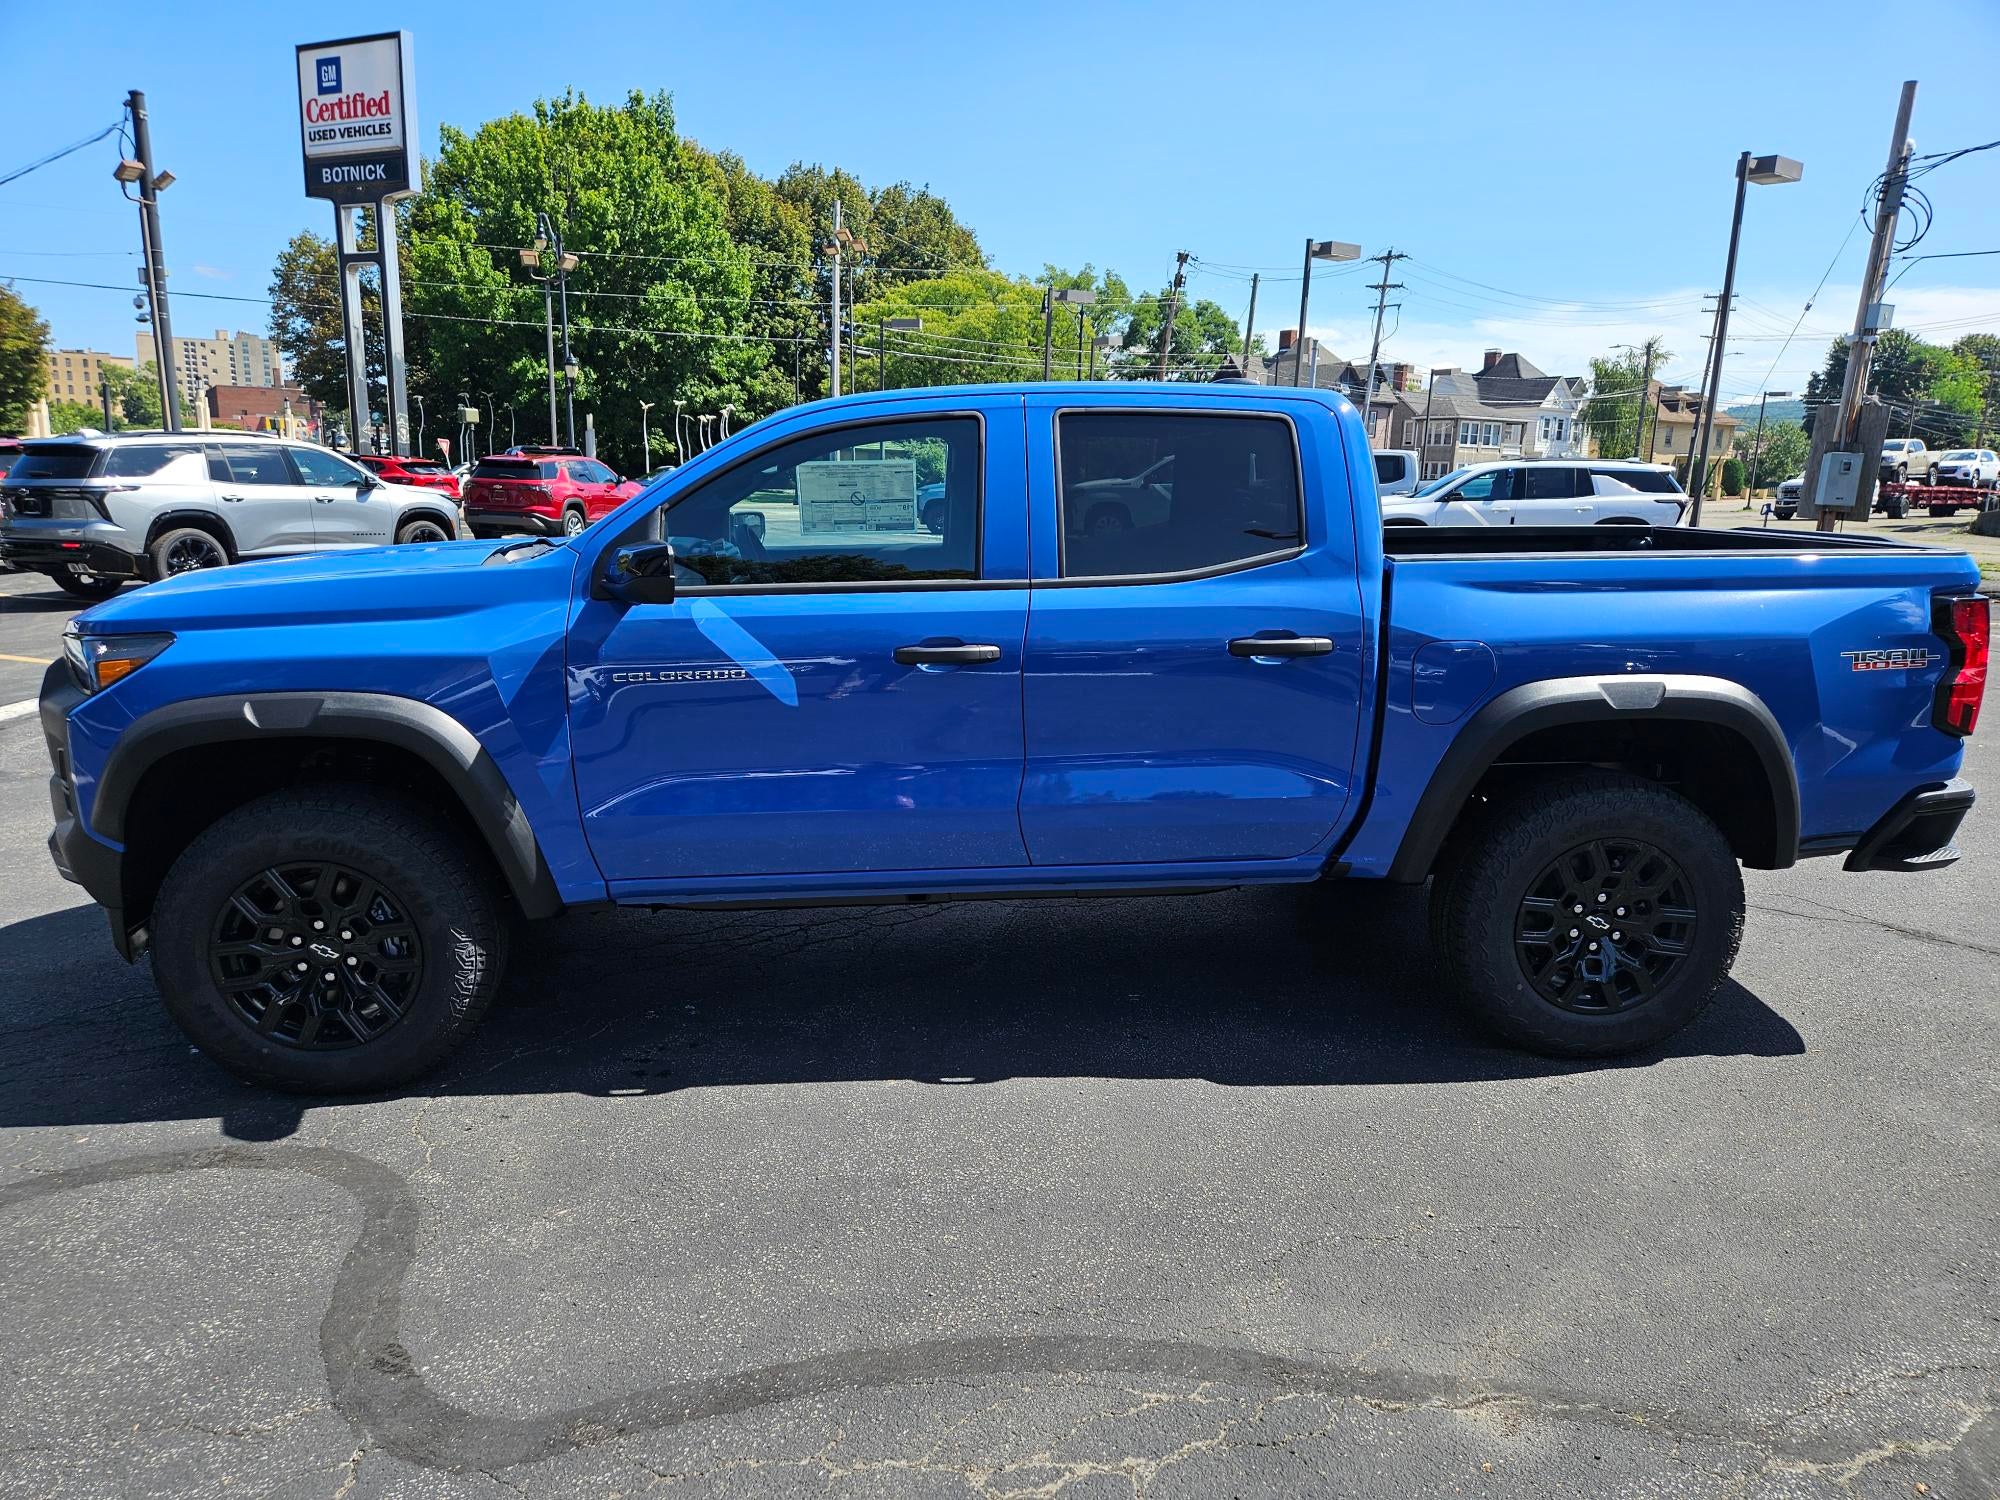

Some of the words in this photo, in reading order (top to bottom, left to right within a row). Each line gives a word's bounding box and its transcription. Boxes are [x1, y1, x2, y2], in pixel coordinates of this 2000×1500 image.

[321, 65, 337, 81] GM
[306, 90, 391, 123] Certified
[308, 128, 337, 142] USED
[338, 123, 392, 139] VEHICLES
[322, 164, 386, 183] BOTNICK
[1841, 648, 1941, 663] TRAIL
[1852, 660, 1928, 672] BOSS
[612, 669, 746, 682] COLORADO
